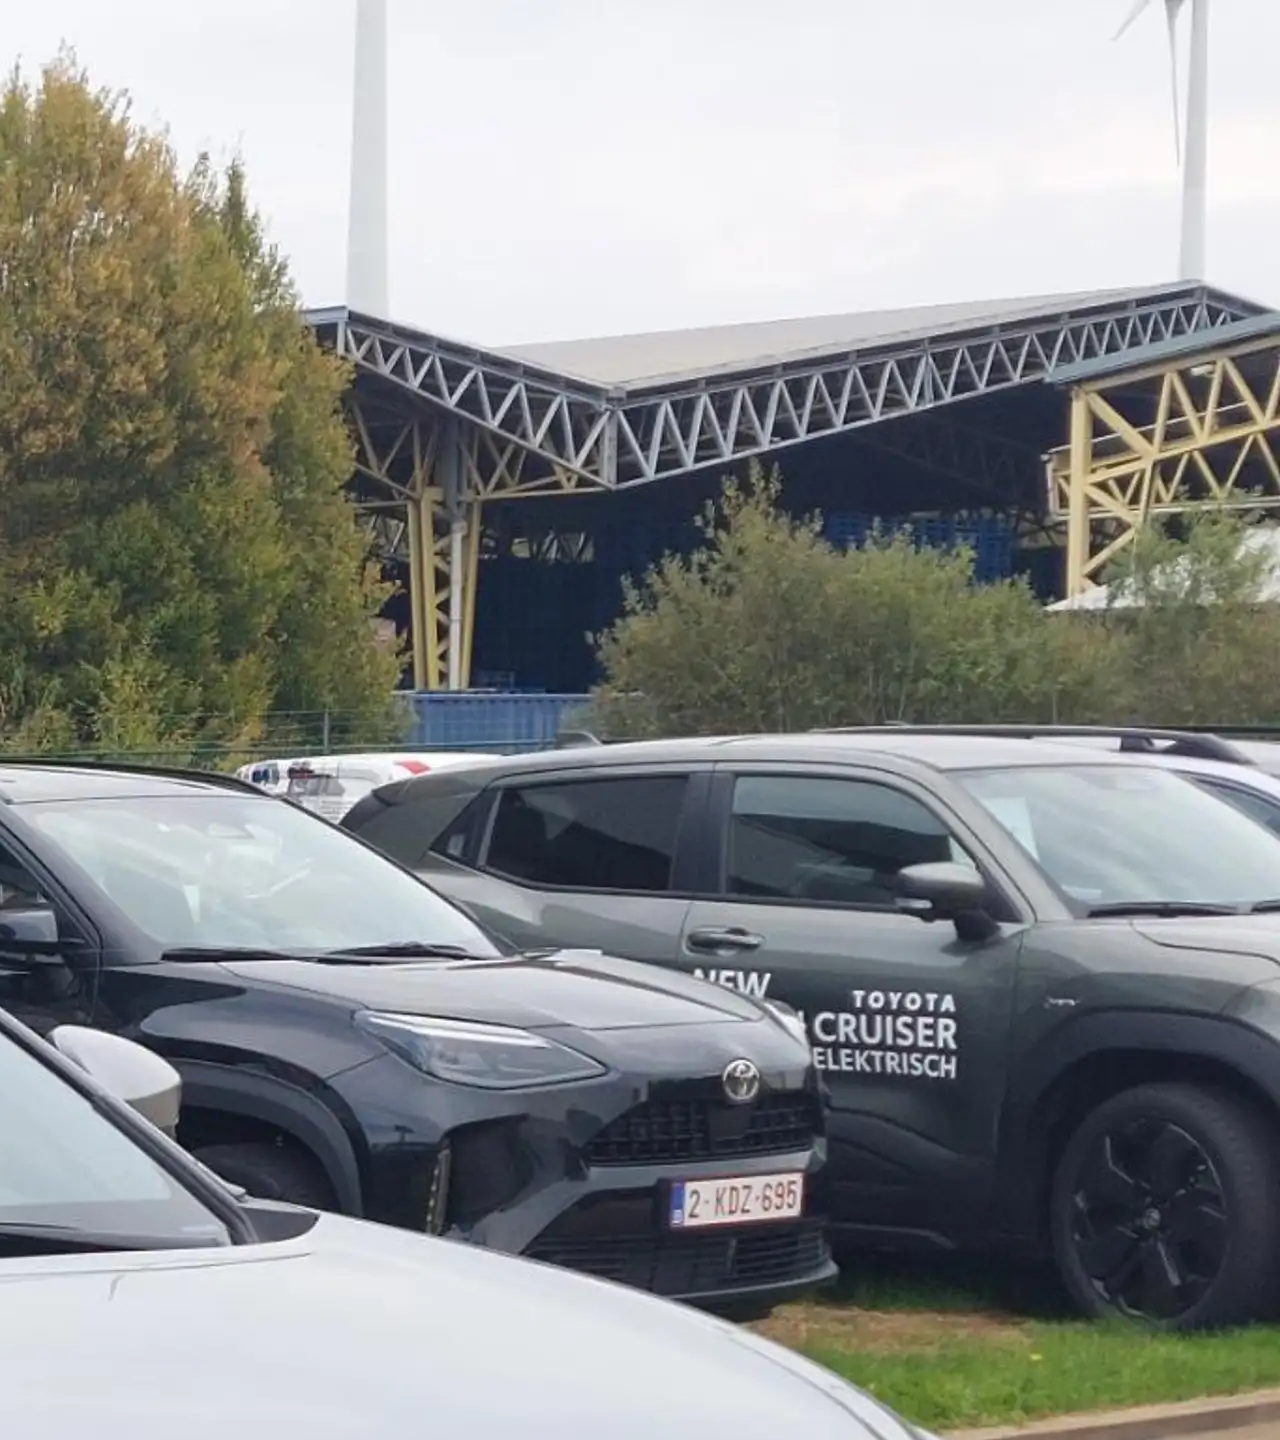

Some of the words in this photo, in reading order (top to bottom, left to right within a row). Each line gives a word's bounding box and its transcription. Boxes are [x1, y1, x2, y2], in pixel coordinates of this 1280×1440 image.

[851, 989, 957, 1014] TOYOTA
[813, 1010, 958, 1050] CRUISER
[812, 1046, 958, 1080] ELEKTRISCH
